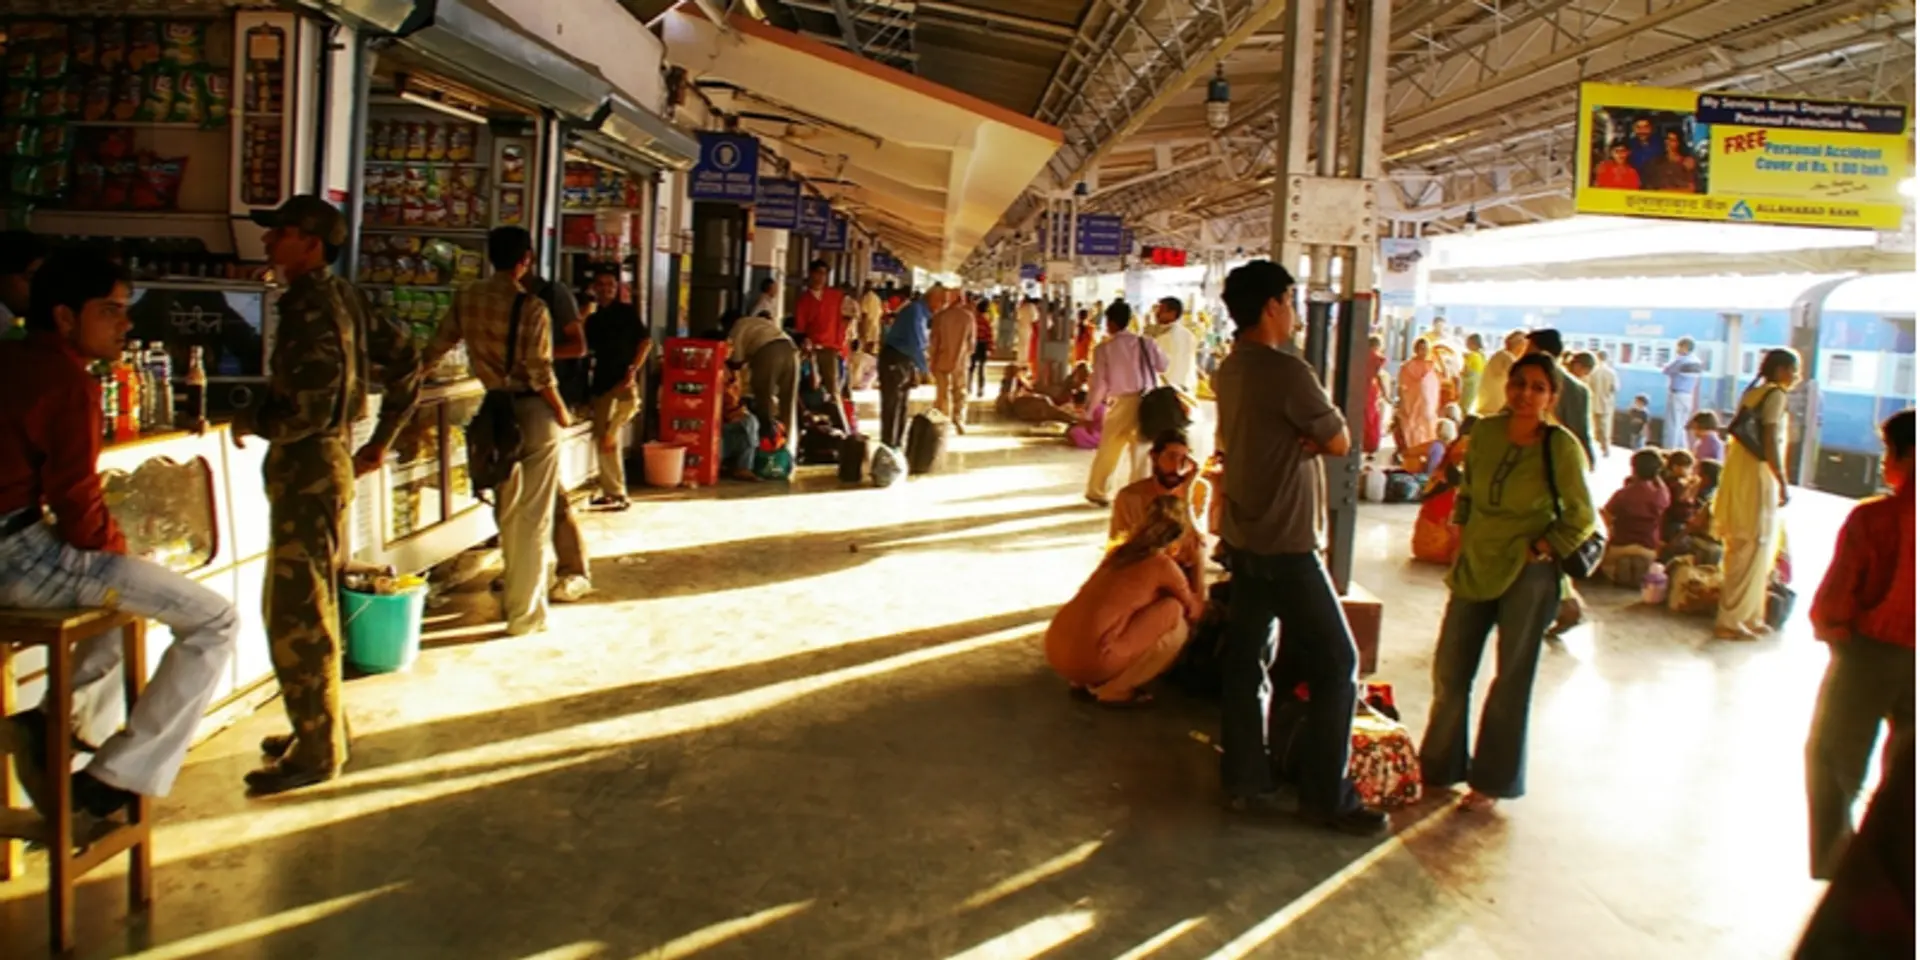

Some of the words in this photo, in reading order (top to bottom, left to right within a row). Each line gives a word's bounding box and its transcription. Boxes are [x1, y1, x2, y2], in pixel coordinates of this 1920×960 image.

[1701, 96, 1719, 109] My
[1722, 98, 1765, 112] Savings
[1769, 100, 1798, 111] Bank
[1851, 104, 1881, 118] gives
[1884, 108, 1902, 118] me
[1735, 112, 1785, 125] Personal
[1788, 114, 1844, 128] Protection
[1724, 130, 1767, 155] FREE
[1764, 141, 1822, 156] Personal
[1824, 145, 1882, 159] Accident
[1756, 156, 1794, 171] Cover
[1756, 203, 1825, 215] ALLAHABAD
[1829, 207, 1860, 218] BANK
